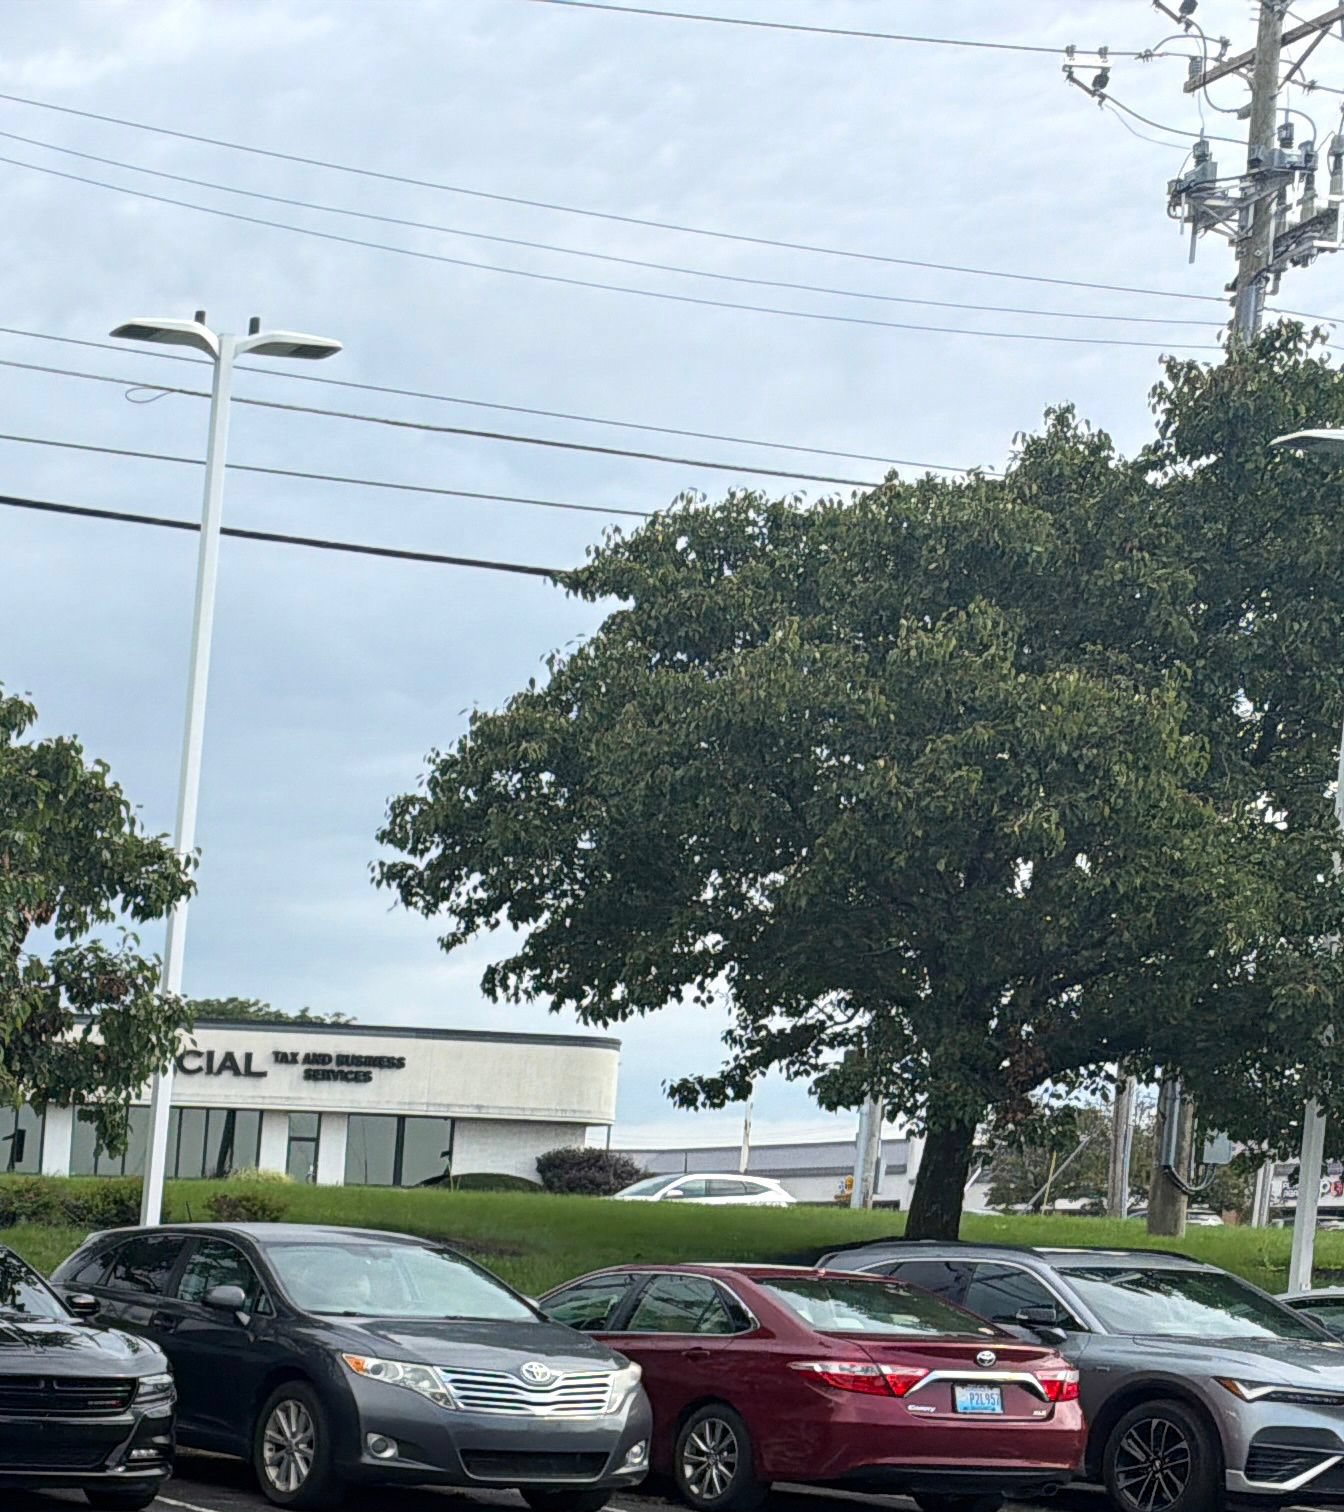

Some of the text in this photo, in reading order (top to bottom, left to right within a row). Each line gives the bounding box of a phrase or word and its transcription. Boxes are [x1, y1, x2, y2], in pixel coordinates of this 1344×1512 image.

[272, 1050, 300, 1065] TAX
[302, 1051, 333, 1066] AND
[303, 1068, 373, 1083] SERVICES
